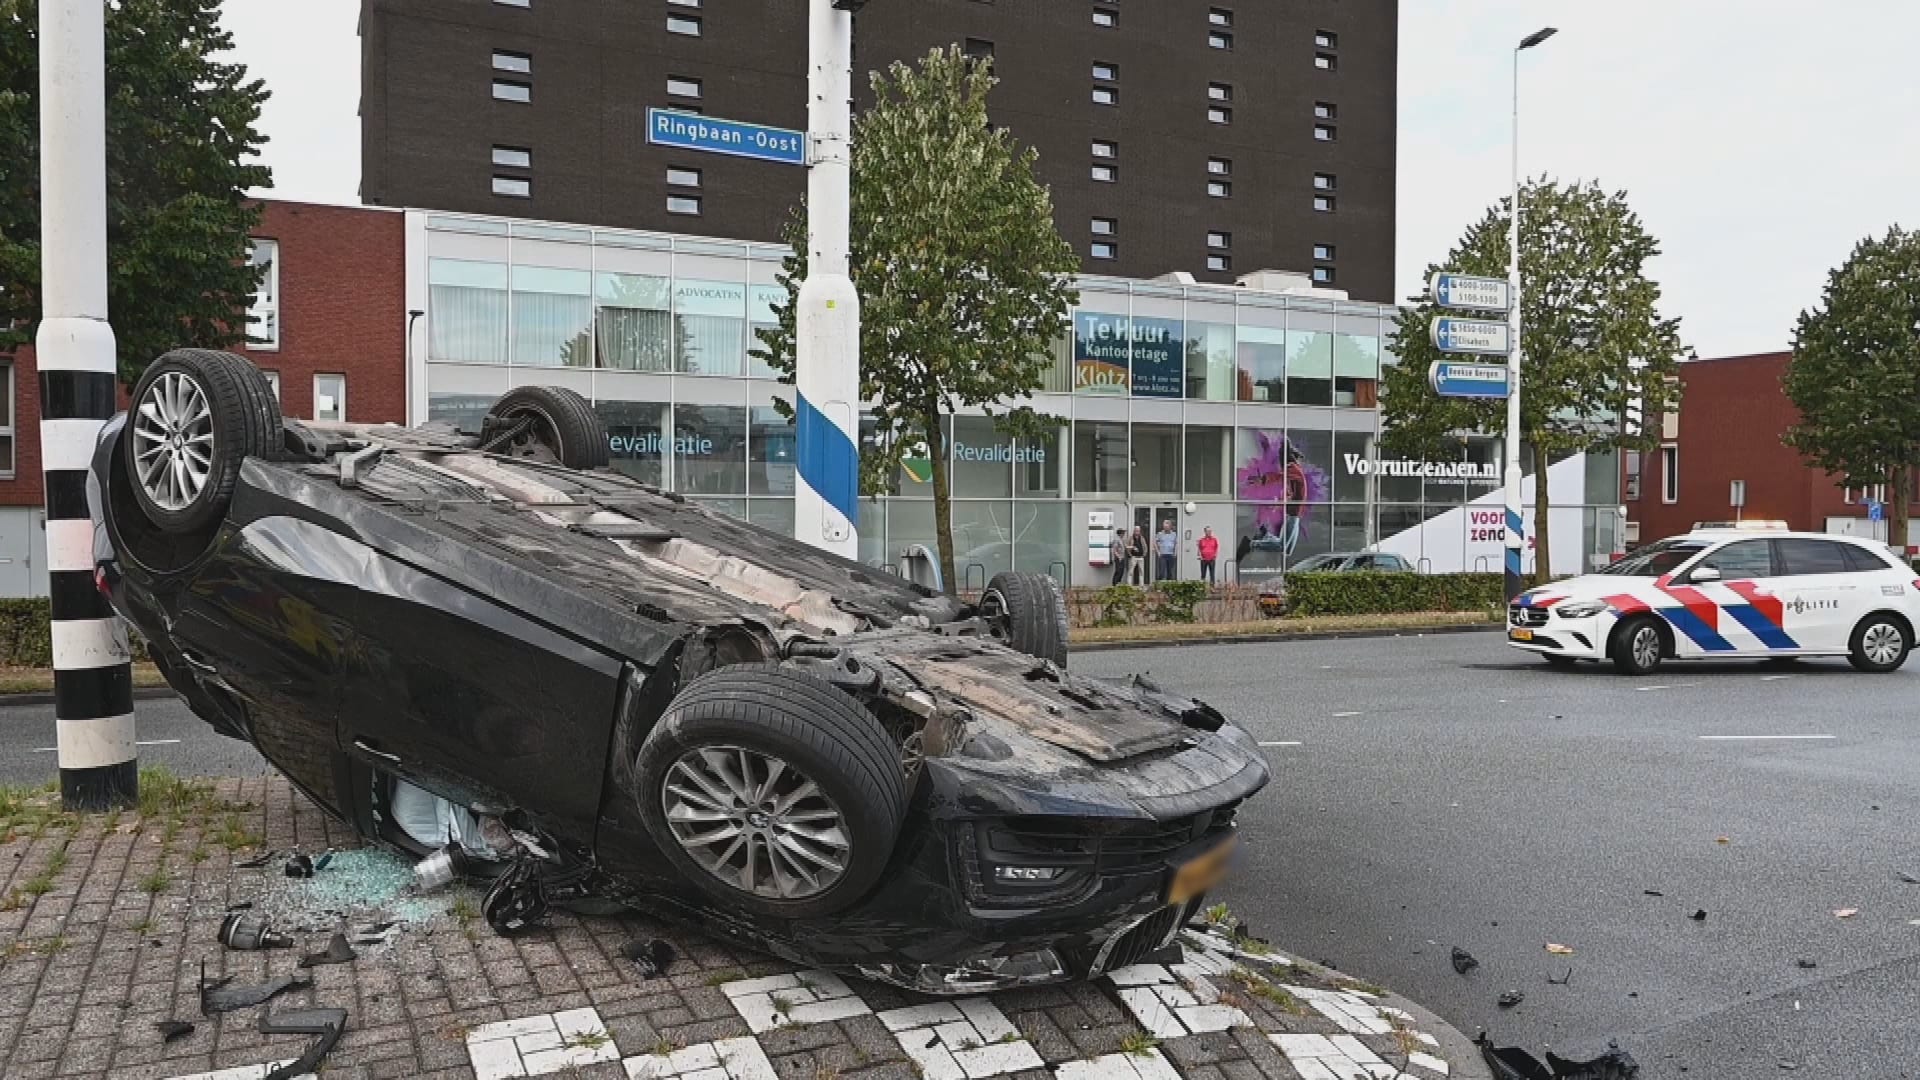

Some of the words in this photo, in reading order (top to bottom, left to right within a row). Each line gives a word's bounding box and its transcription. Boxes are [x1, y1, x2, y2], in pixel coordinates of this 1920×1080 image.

[657, 115, 741, 144] Ringbaan
[677, 287, 742, 300] ADVOCATEN
[758, 292, 789, 304] KANT
[1085, 316, 1110, 342] Te
[1115, 317, 1167, 344] Huur
[1085, 340, 1169, 363] Kantooretage
[1076, 364, 1126, 385] Klotz
[605, 431, 713, 455] evalidatie
[953, 441, 1046, 463] Revalidatie
[1343, 453, 1500, 478] Vooruitzenden.nl
[1470, 511, 1505, 525] voor
[1470, 526, 1505, 542] zend
